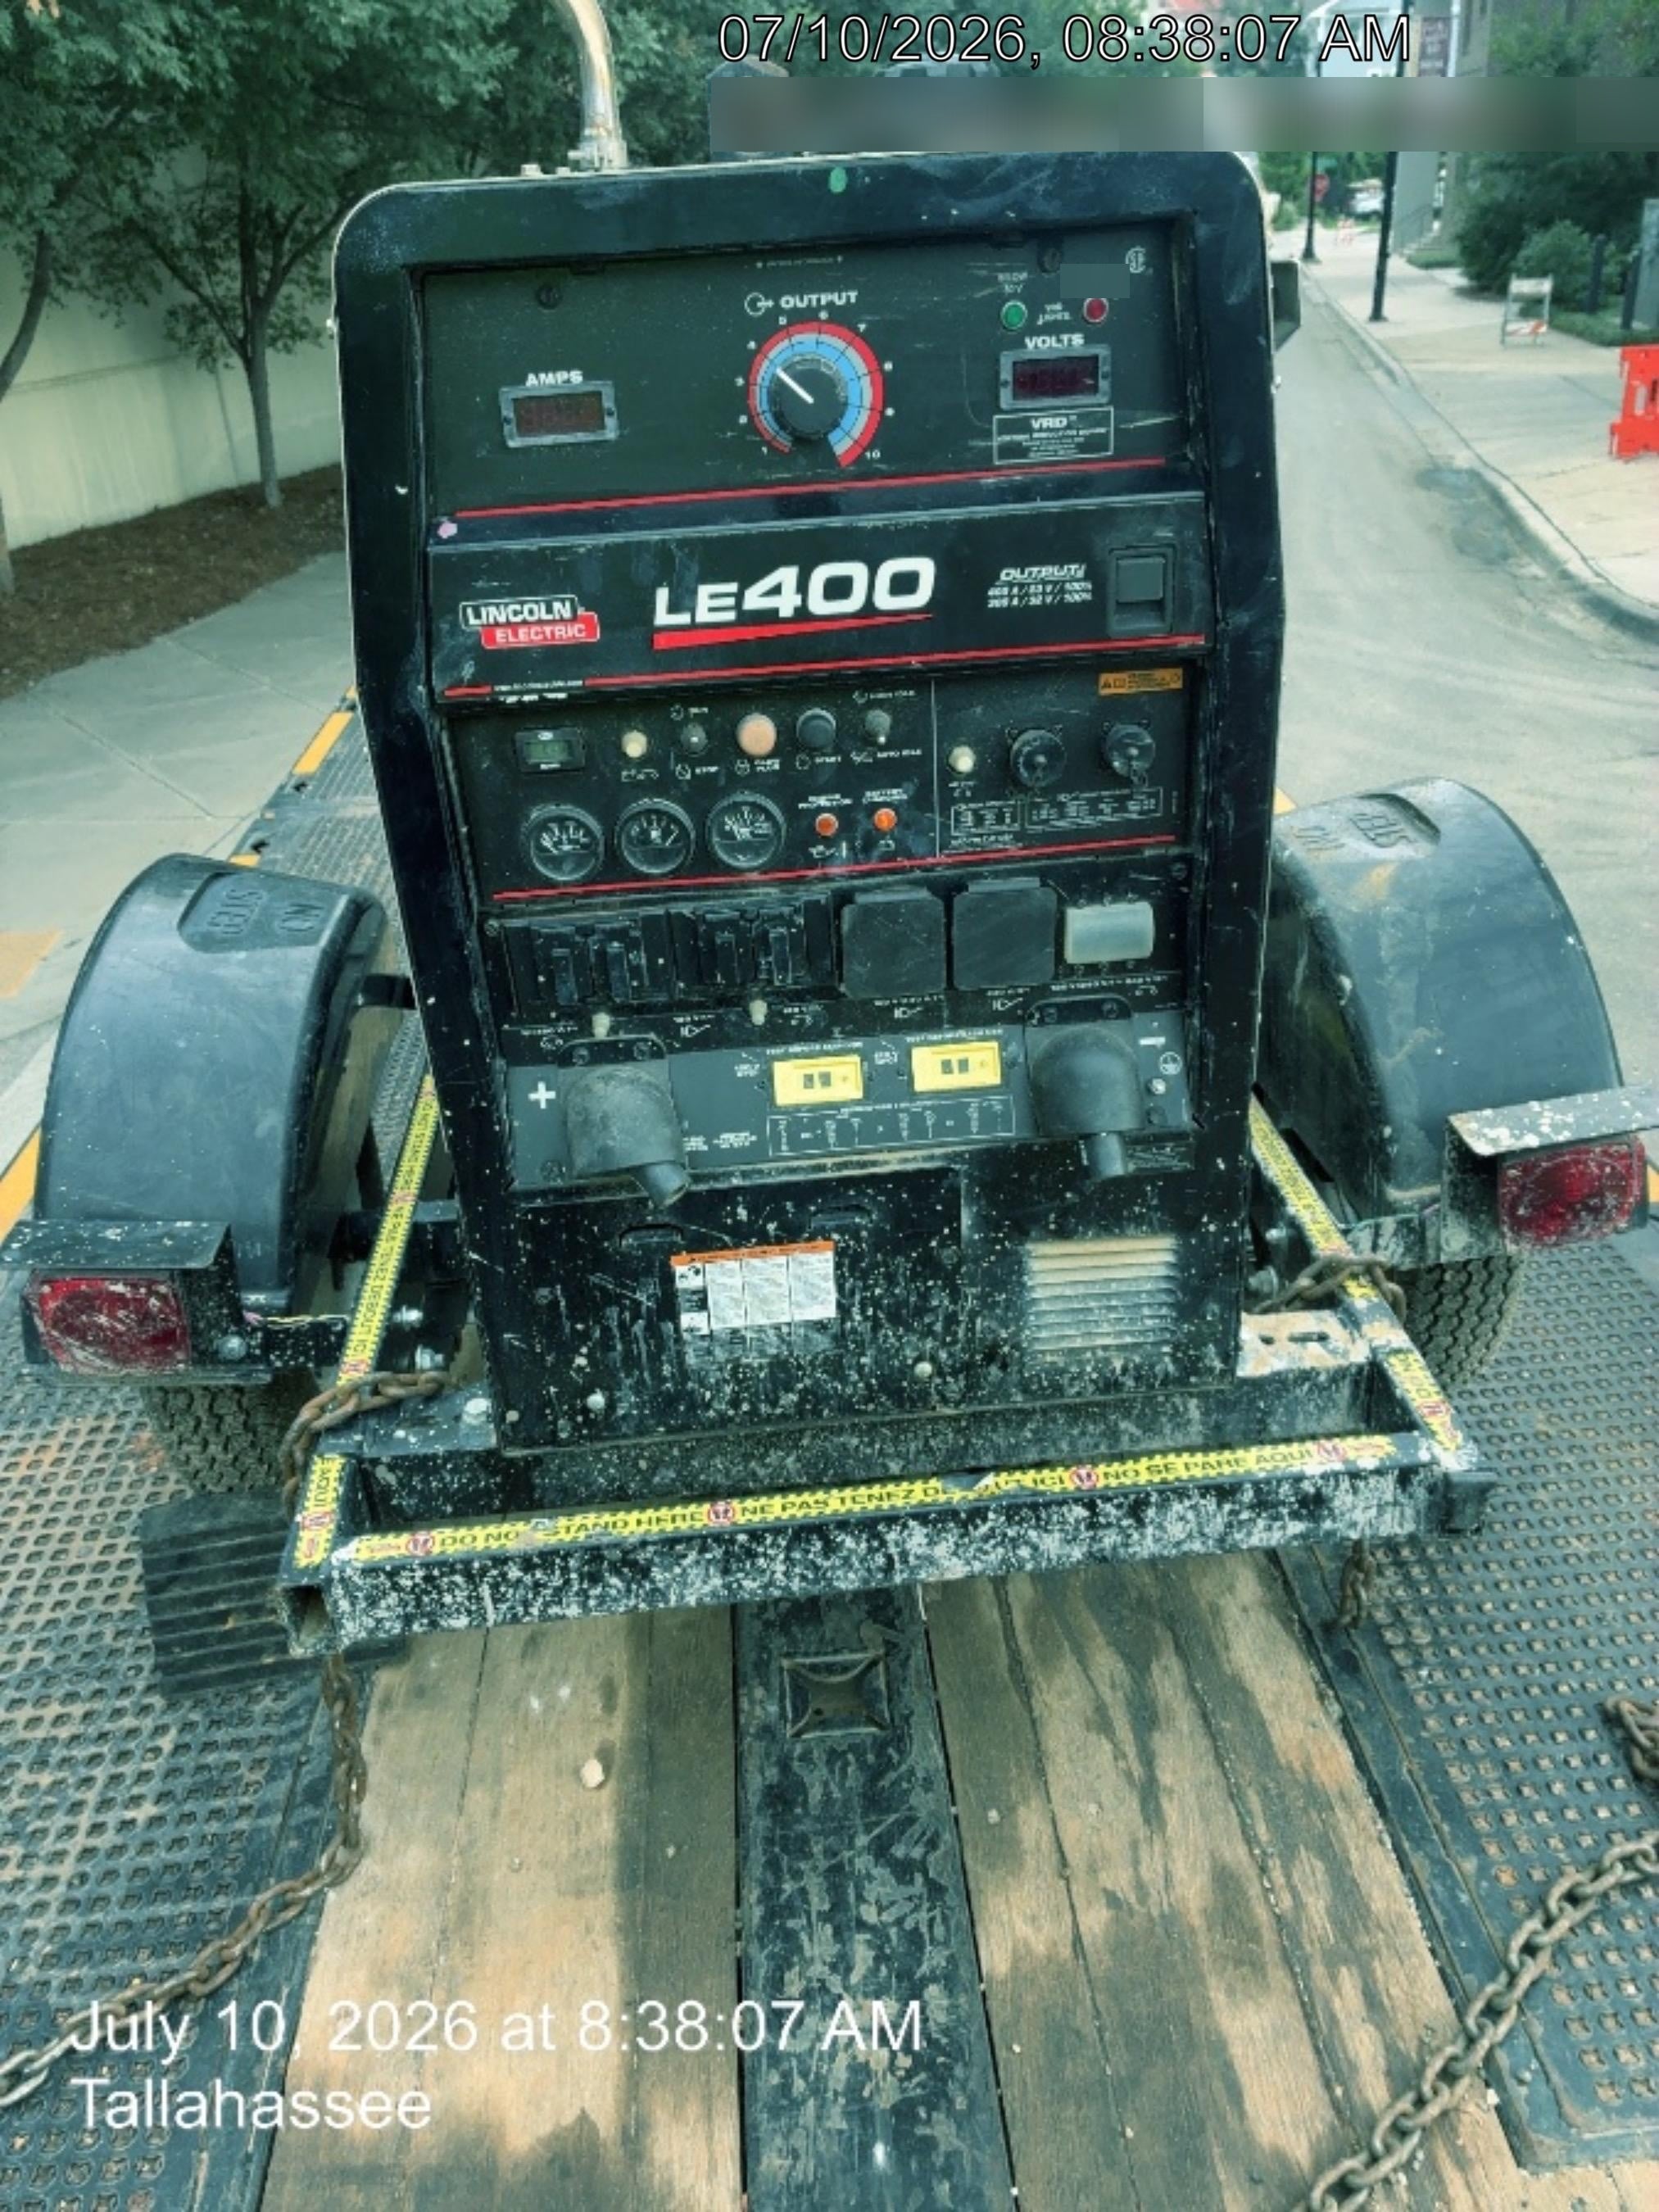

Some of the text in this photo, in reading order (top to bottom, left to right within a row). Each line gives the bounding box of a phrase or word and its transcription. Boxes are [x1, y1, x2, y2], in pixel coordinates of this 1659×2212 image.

[780, 291, 858, 309] OUTPUT
[1024, 333, 1085, 350] VOLTS
[525, 370, 583, 387] AMPS
[1031, 417, 1067, 429] VRD
[865, 450, 881, 460] 10
[999, 563, 1083, 581] OUTPUT
[653, 557, 936, 626] LE400
[466, 599, 573, 626] LINCOLN
[495, 623, 587, 643] ELECTRIC
[1104, 1445, 1311, 1481] NO SE PARE AQUI
[1032, 1474, 1065, 1487] ICI
[742, 1503, 774, 1516] NE
[781, 1498, 829, 1512] PAS
[838, 1488, 915, 1507] TENEZ
[441, 1534, 477, 1547] DO
[636, 1511, 705, 1528] HERE
